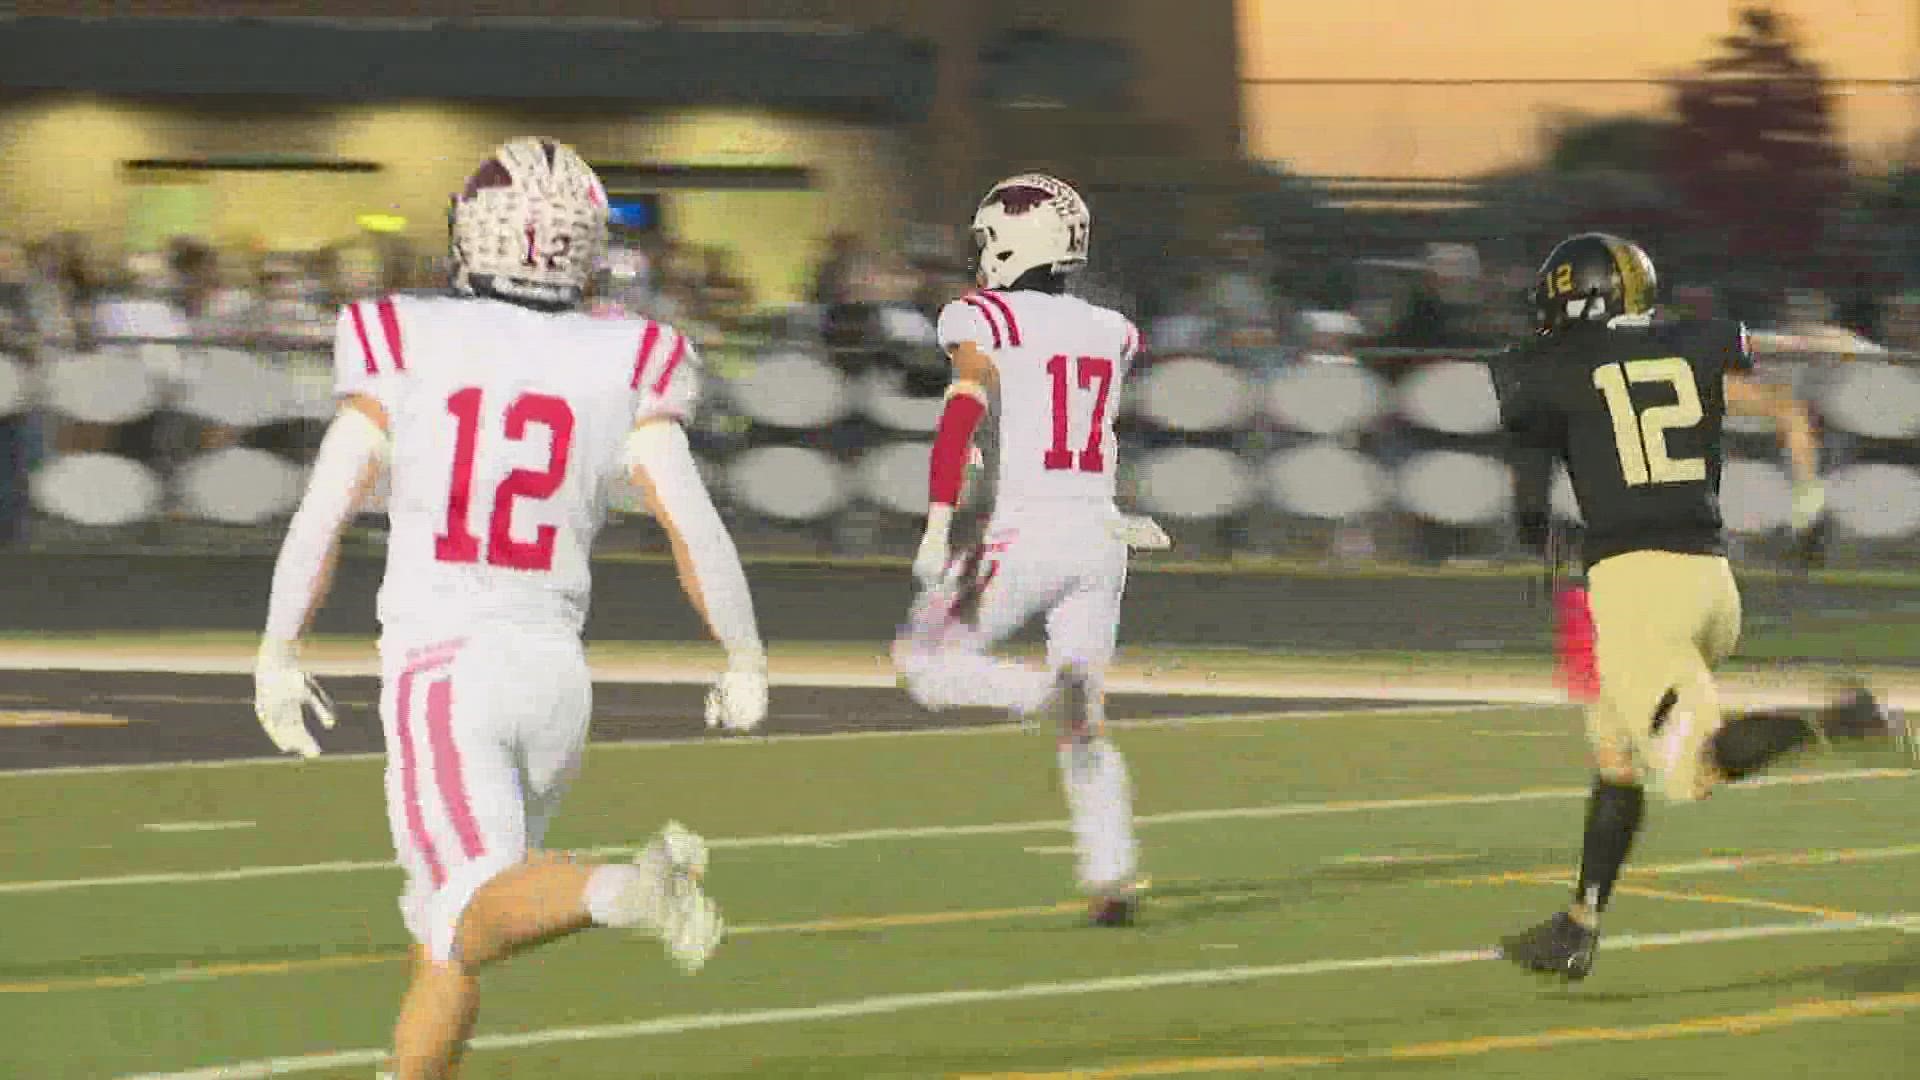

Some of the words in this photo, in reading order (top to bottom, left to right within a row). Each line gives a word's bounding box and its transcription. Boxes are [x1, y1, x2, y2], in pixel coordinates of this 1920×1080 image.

[521, 224, 571, 272] 12
[1547, 264, 1573, 298] 12
[1044, 355, 1113, 471] 17
[1593, 358, 1705, 486] 12
[434, 388, 574, 571] 12
